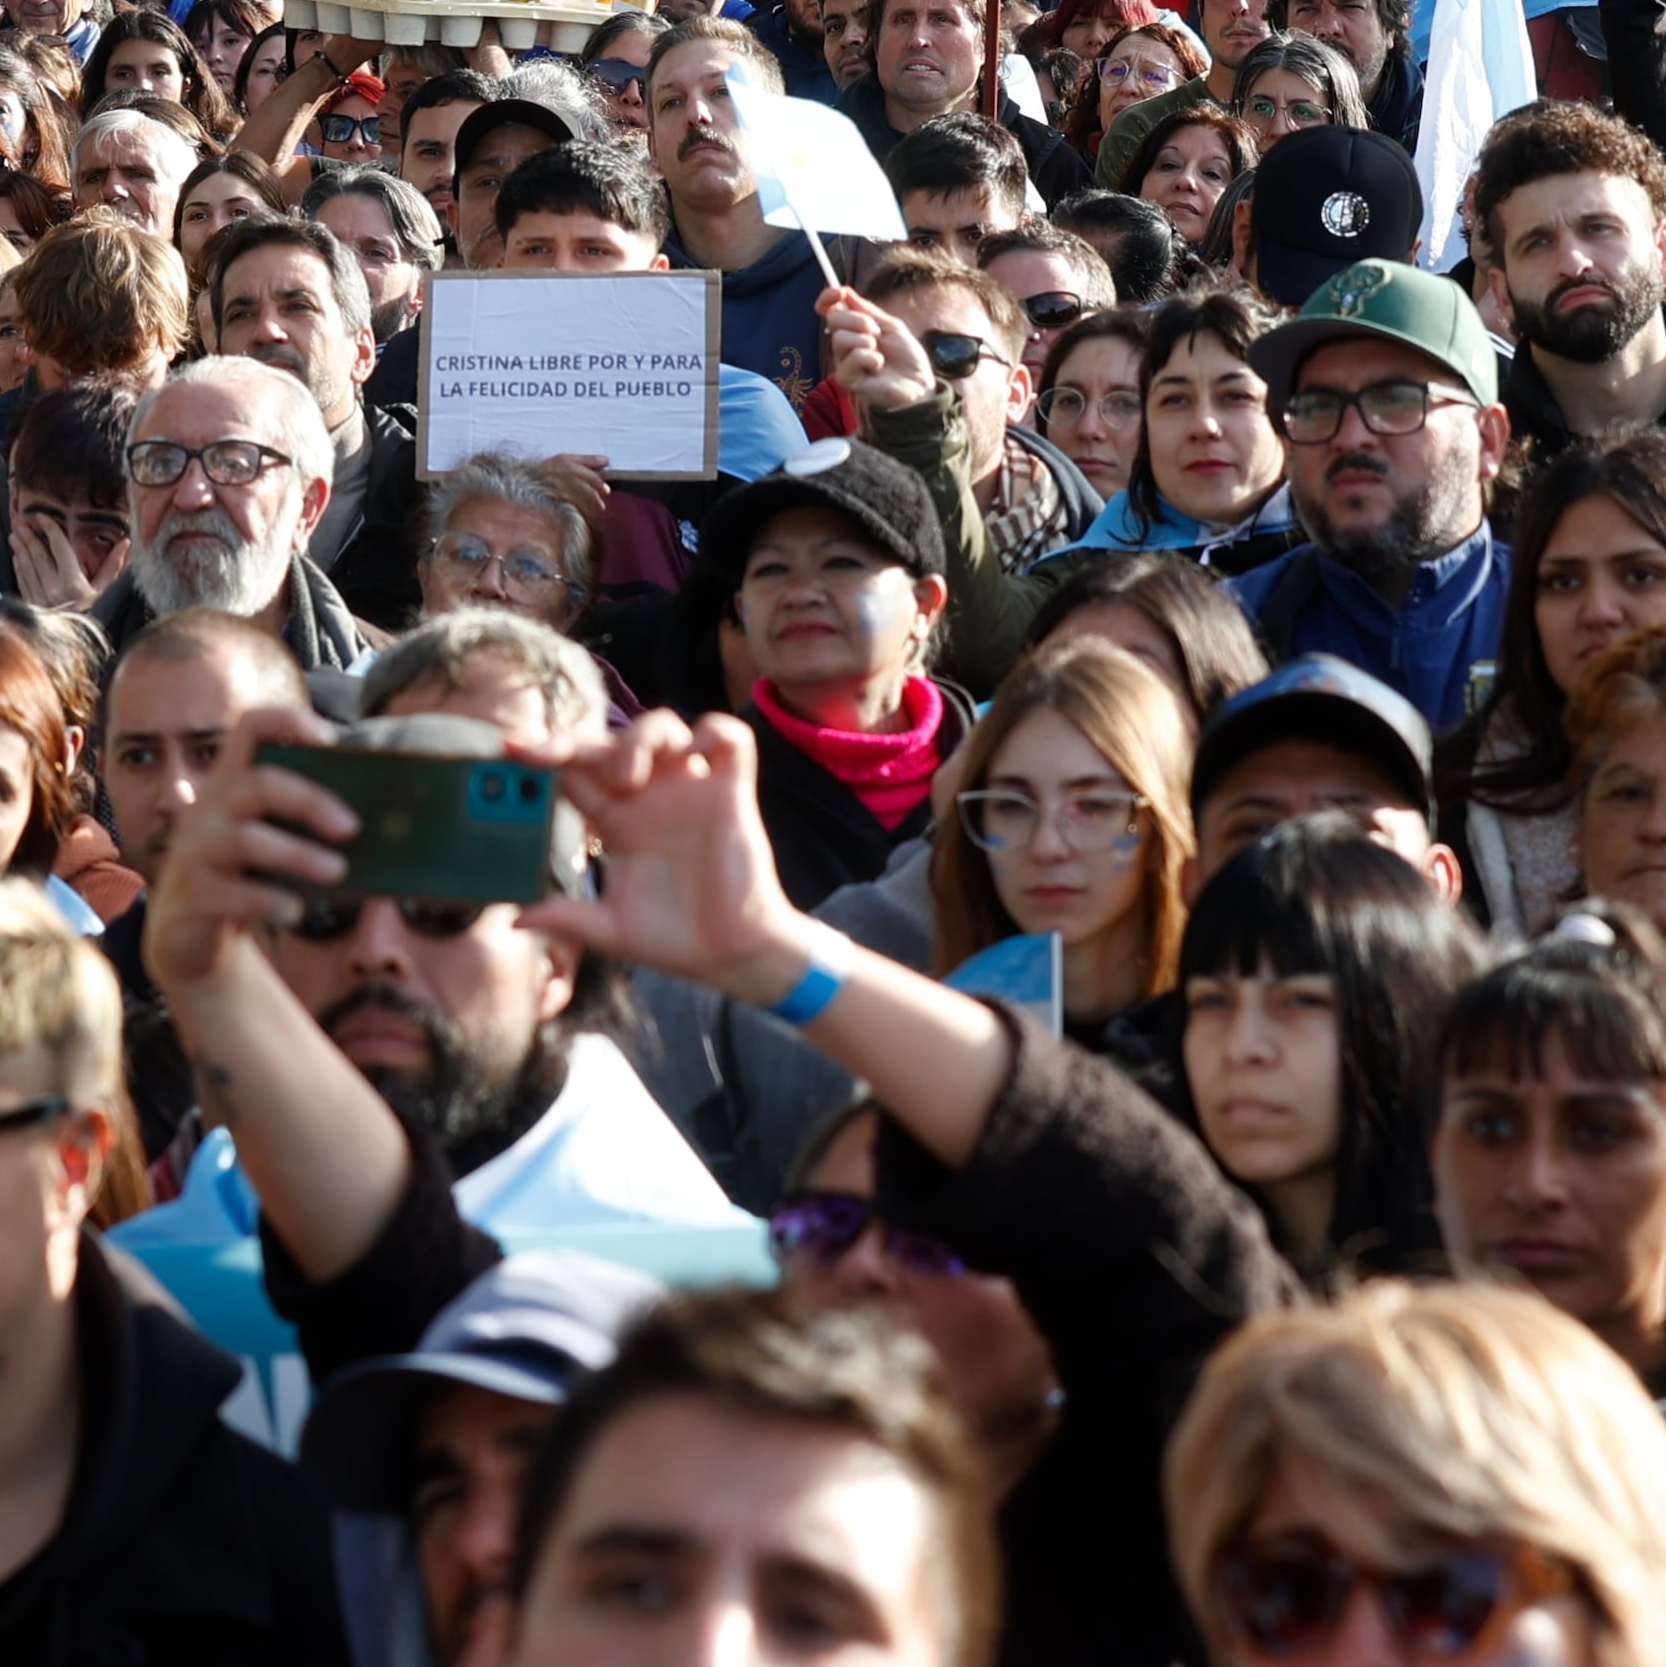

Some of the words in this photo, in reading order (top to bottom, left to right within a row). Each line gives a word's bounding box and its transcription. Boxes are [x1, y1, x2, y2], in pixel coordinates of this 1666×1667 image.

[436, 355, 523, 371] CRISTINA
[530, 355, 582, 371] LIBRE
[589, 354, 628, 370] POR
[634, 354, 645, 369] Y
[650, 354, 702, 370] PARA
[440, 383, 463, 398] LA
[469, 382, 567, 398] FELICIDAD
[574, 382, 609, 398] DEL
[615, 382, 691, 397] PUEBLO
